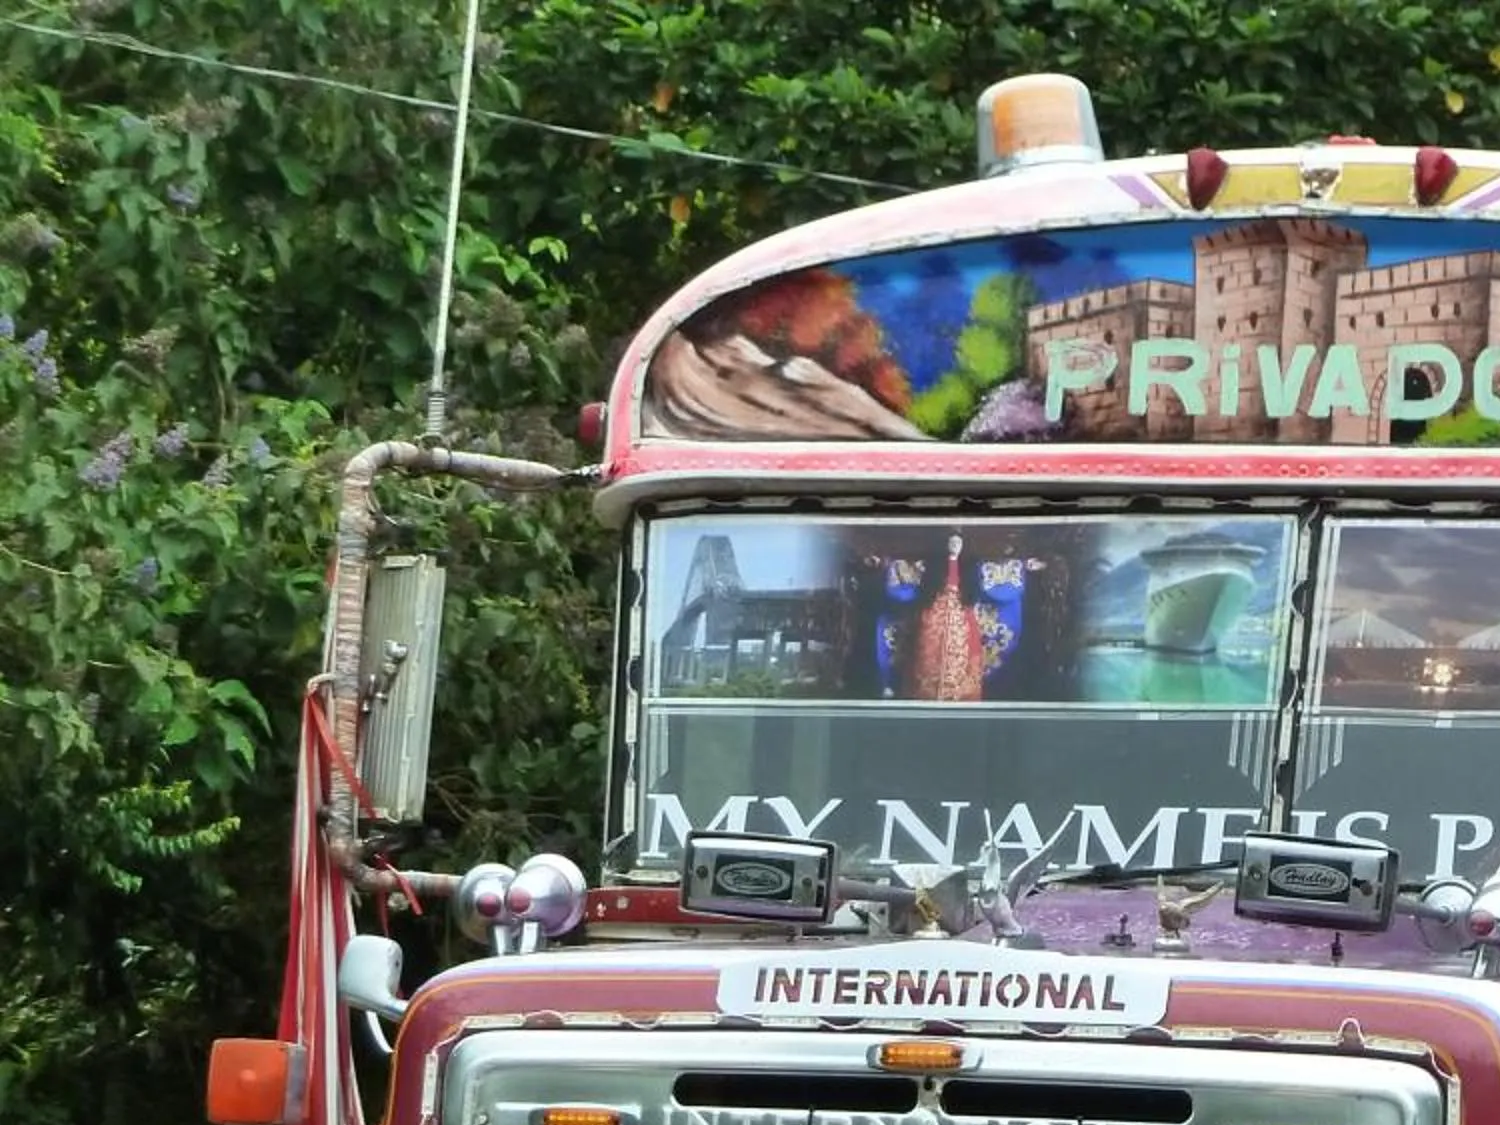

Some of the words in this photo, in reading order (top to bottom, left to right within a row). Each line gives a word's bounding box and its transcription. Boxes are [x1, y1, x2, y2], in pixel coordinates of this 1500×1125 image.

[640, 793, 844, 858] MY
[869, 799, 1263, 871] NAME
[754, 966, 1126, 1013] INTERNATIONAL
